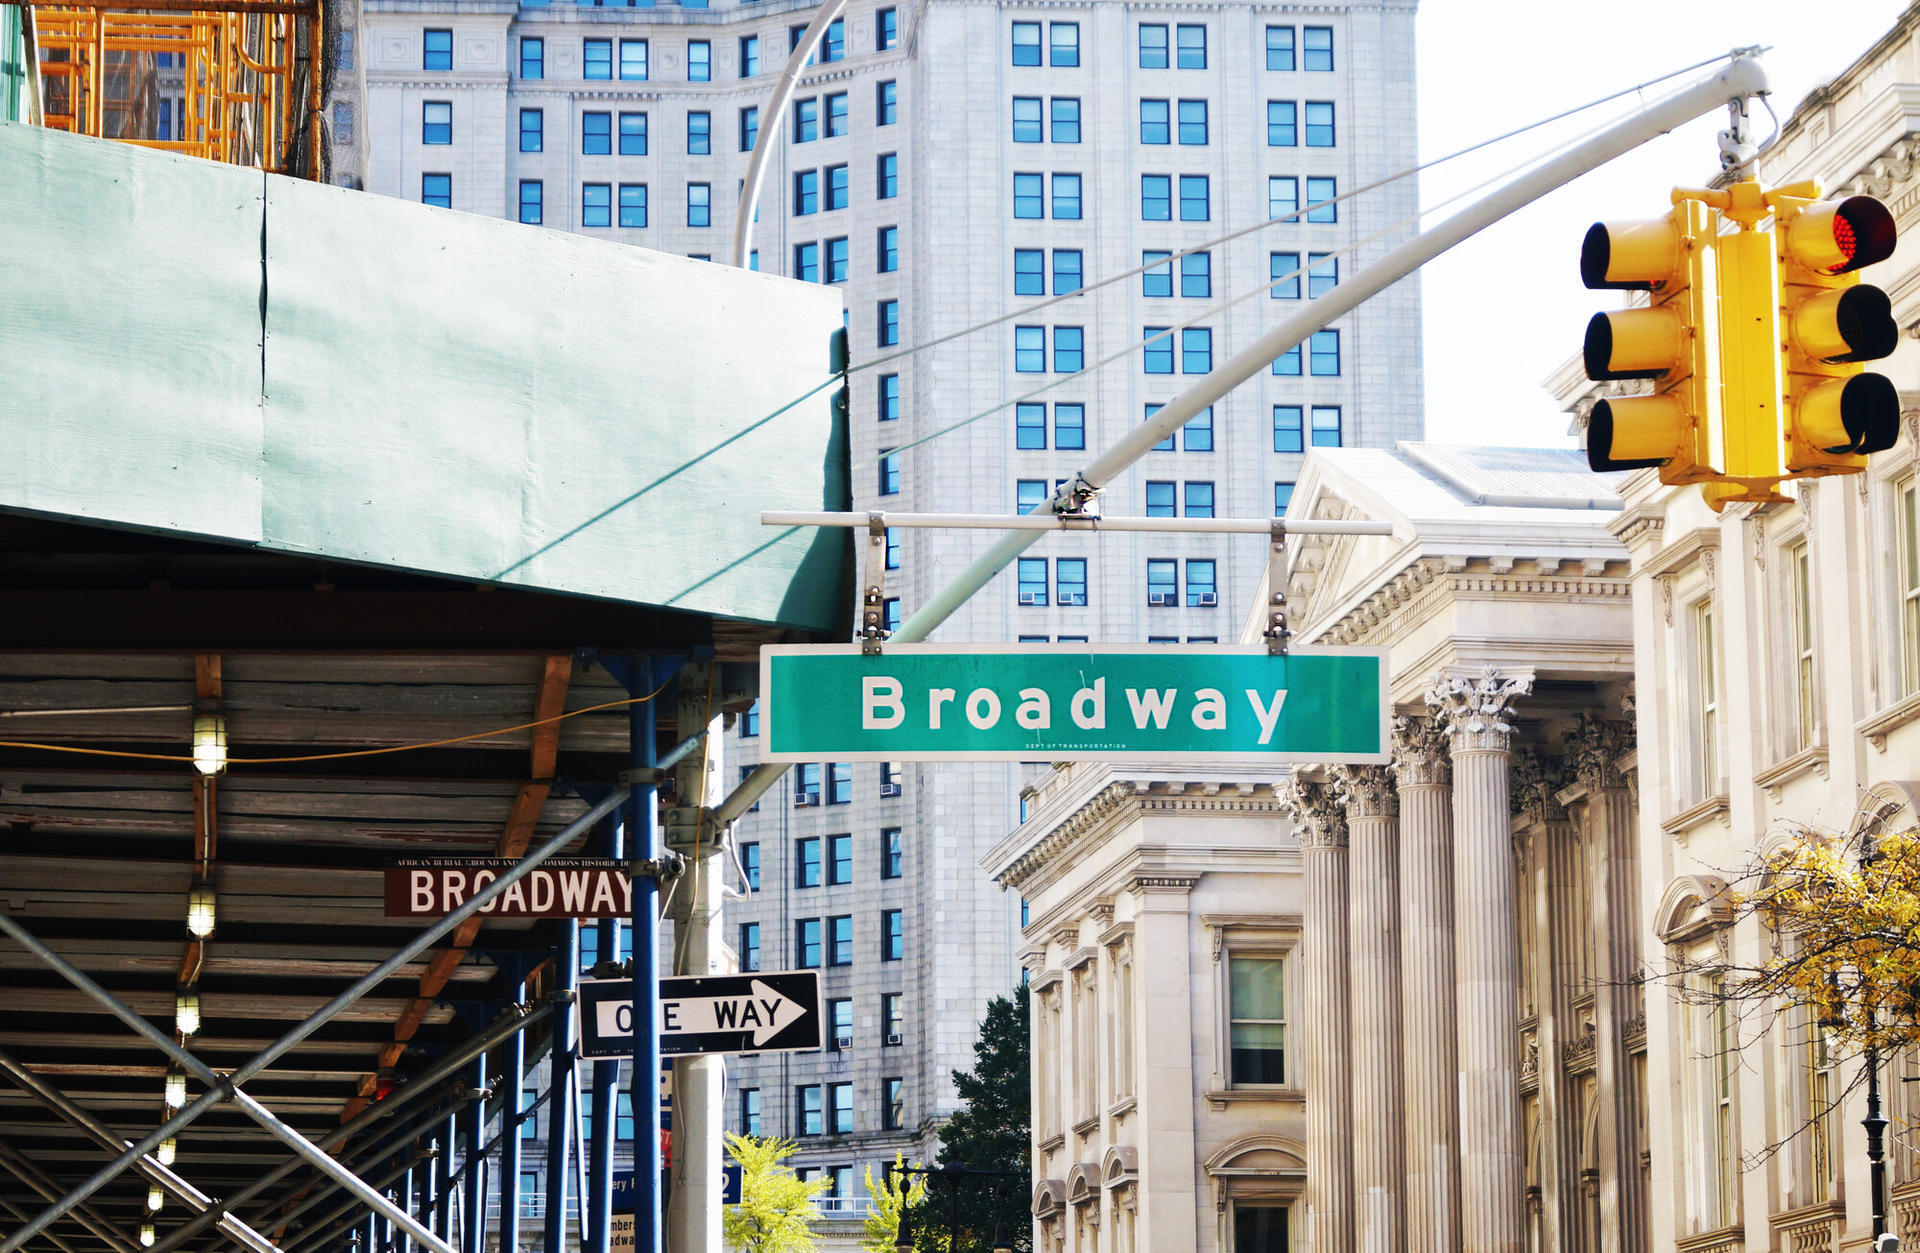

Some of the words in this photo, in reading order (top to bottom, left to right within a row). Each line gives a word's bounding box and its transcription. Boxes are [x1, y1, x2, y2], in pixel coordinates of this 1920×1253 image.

[862, 676, 1288, 745] Broadway
[540, 859, 579, 867] OMMONS
[581, 859, 617, 867] HISTORIC
[410, 869, 632, 913] BROADWAY
[615, 1002, 682, 1033] OE
[713, 998, 782, 1029] WAY
